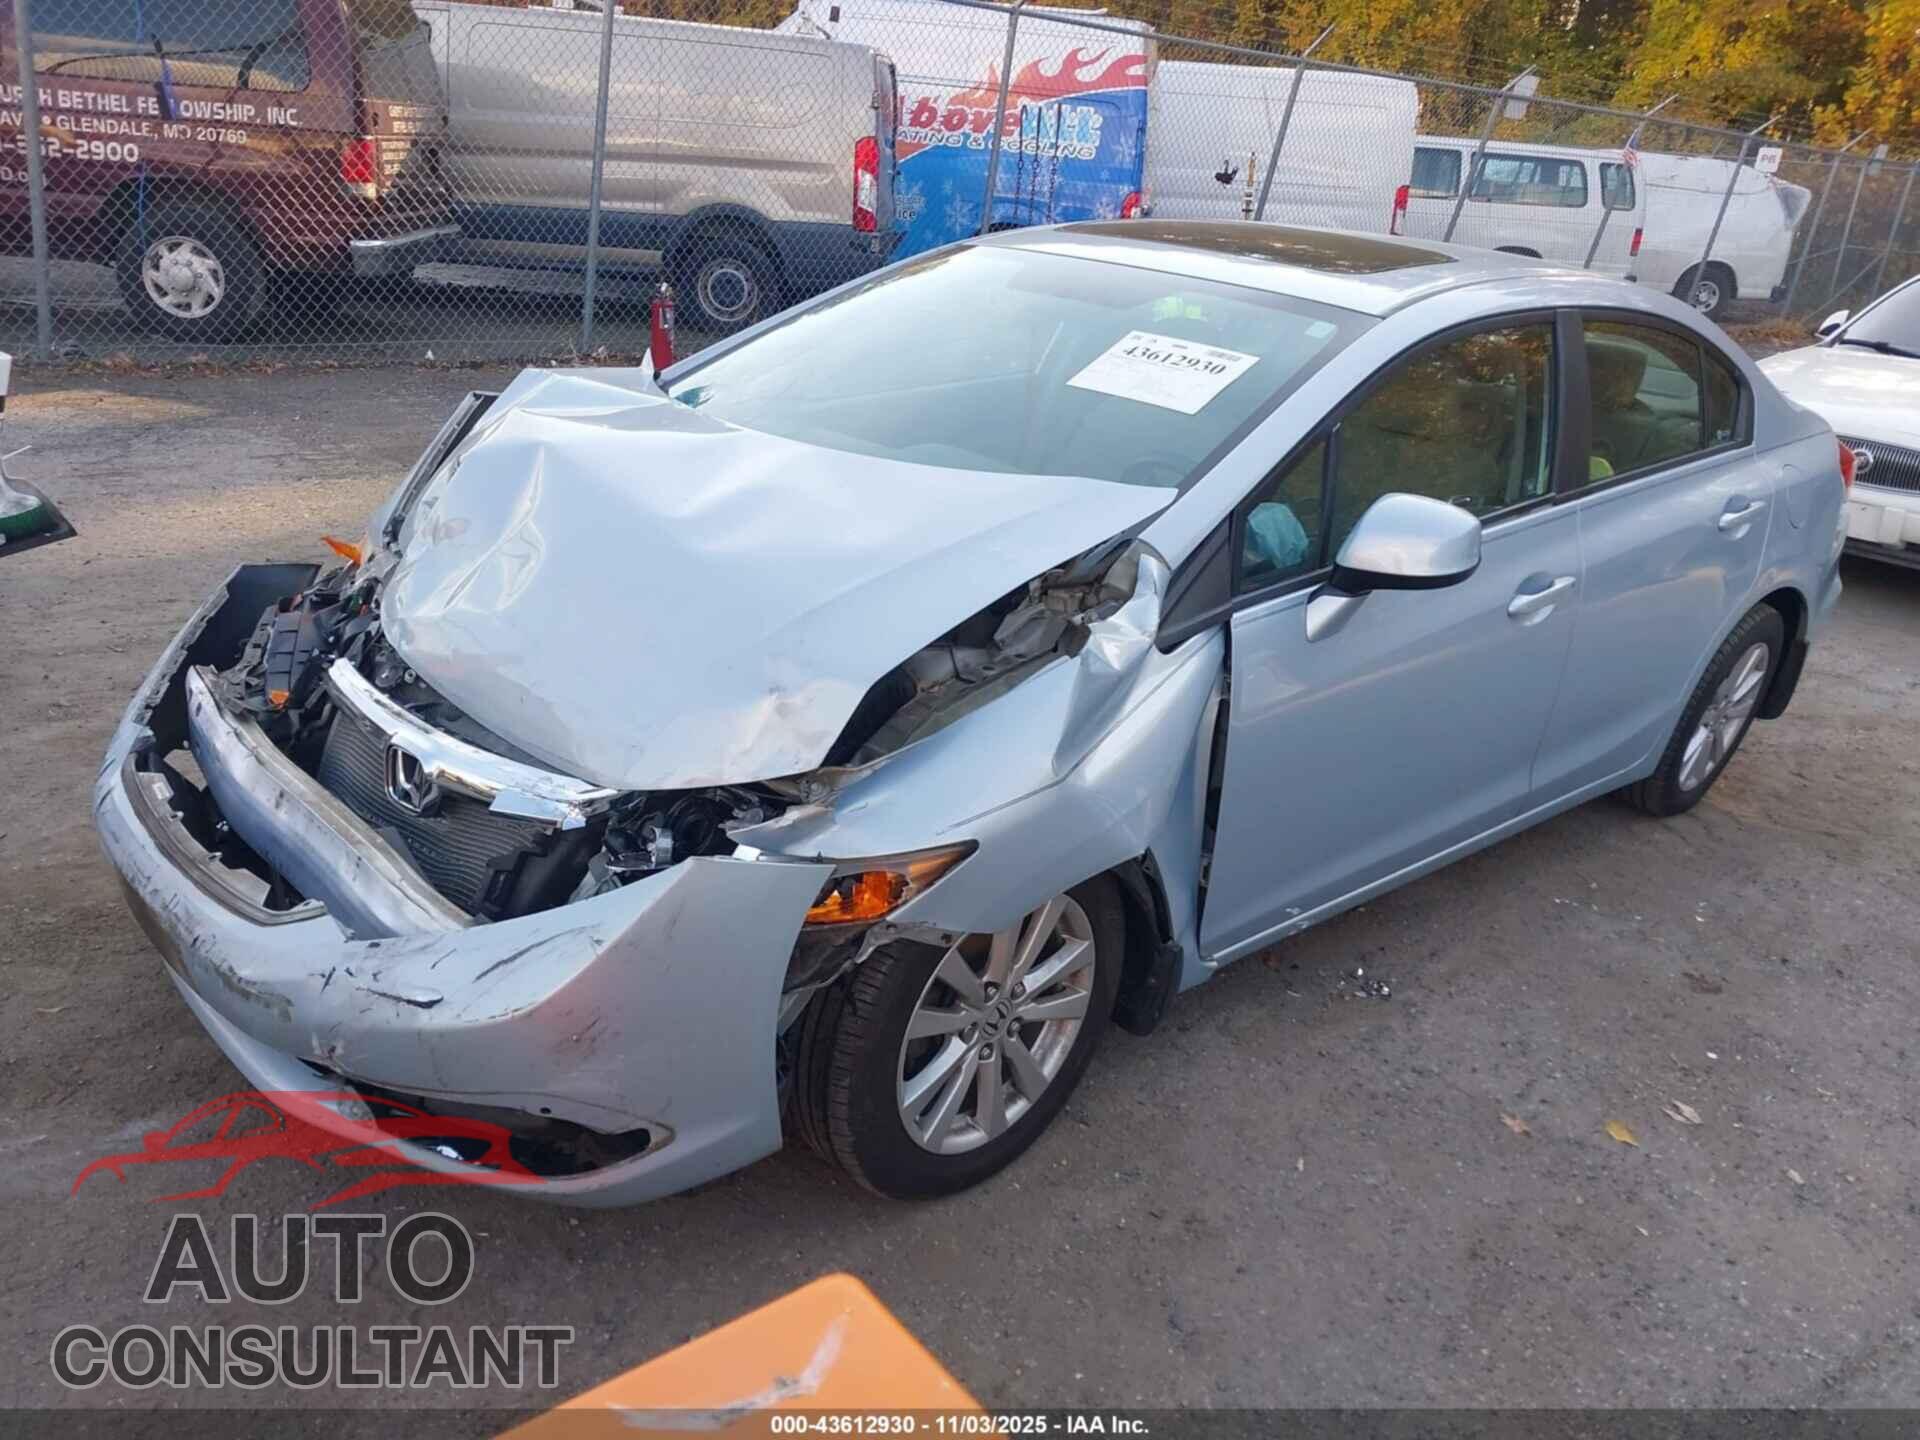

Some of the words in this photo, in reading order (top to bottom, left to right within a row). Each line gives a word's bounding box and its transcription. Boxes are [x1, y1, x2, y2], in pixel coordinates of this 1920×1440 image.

[58, 90, 130, 113] BETHEL
[137, 96, 261, 123] FEOWSHIP,
[267, 106, 303, 126] INC.
[196, 127, 247, 144] 20769
[967, 135, 985, 149] &
[1123, 346, 1226, 376] 43612930
